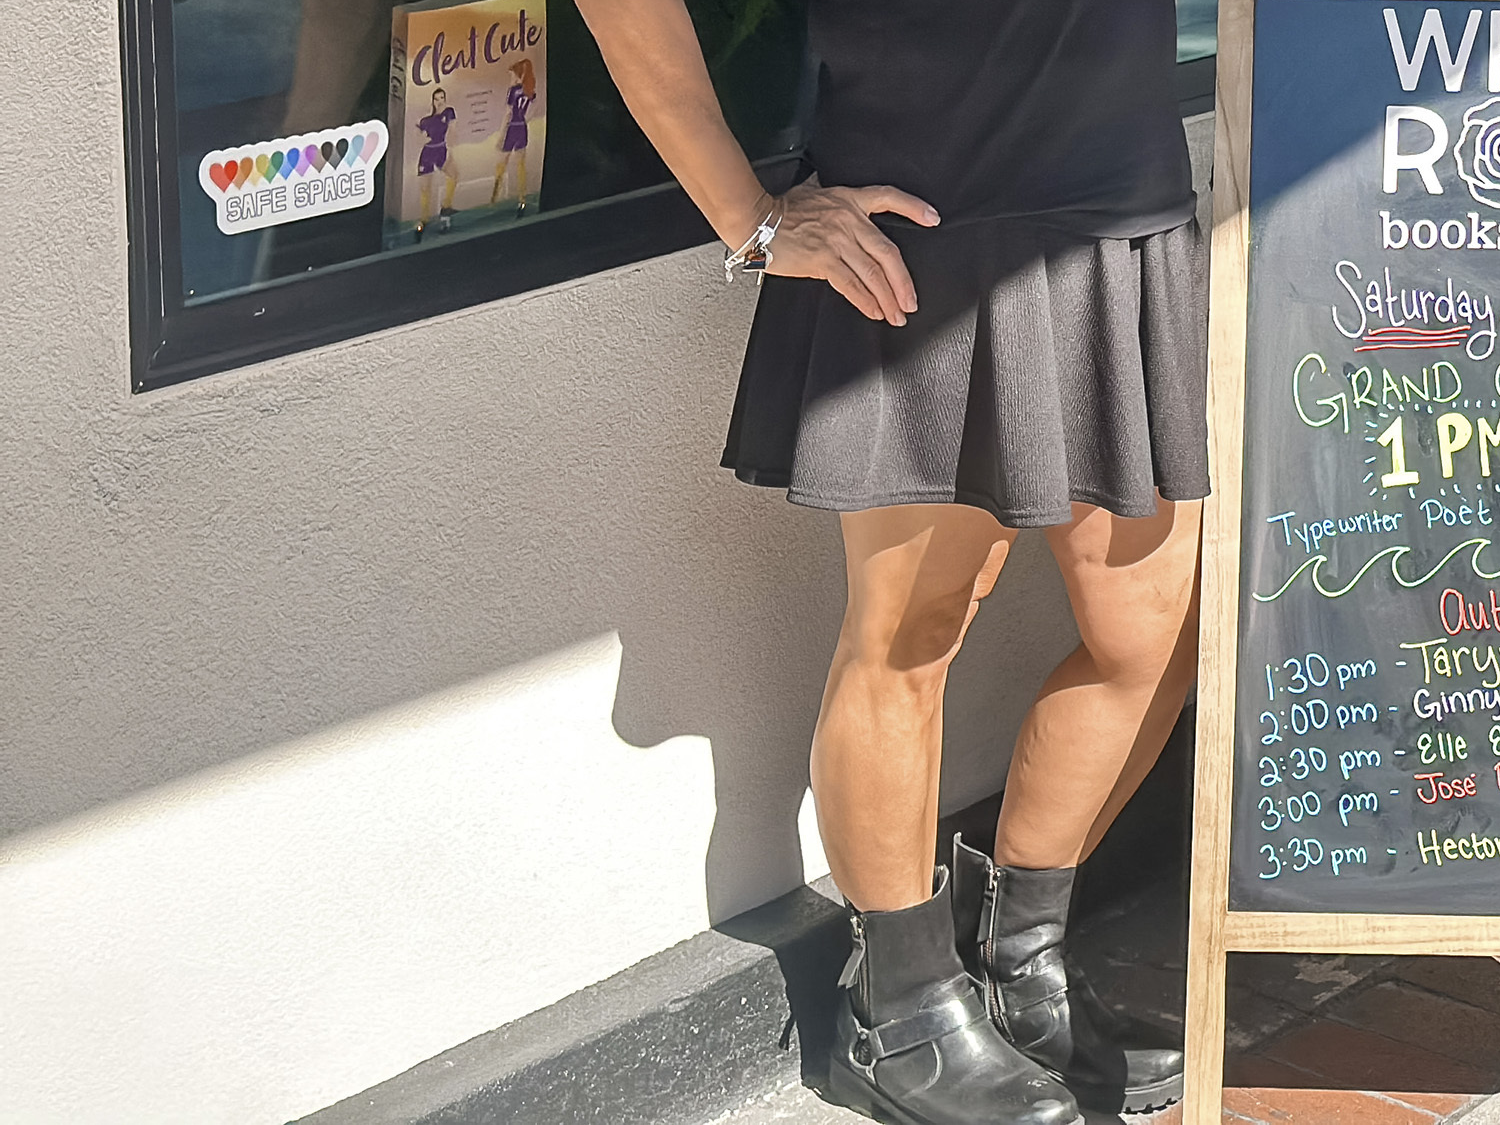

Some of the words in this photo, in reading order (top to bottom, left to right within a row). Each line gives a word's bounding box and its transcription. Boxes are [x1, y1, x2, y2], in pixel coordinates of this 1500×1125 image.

[411, 25, 478, 86] Cleat
[483, 9, 542, 65] Cute
[226, 186, 287, 223] SAFE
[294, 169, 365, 208] SPACE
[1293, 353, 1462, 433] GRAND
[1376, 415, 1420, 489] 1
[1268, 511, 1404, 554] Typewriter
[1265, 653, 1330, 701] 1:30
[1336, 659, 1377, 691] pm
[1259, 698, 1330, 746] 2:00
[1336, 702, 1378, 730] pm
[1259, 746, 1328, 788] 2:30
[1338, 750, 1381, 781] pm
[1416, 732, 1468, 765] Elle
[1258, 791, 1322, 831] 3:00
[1338, 792, 1379, 827] pm
[1258, 837, 1325, 880] 3:30
[1330, 846, 1367, 877] pm
